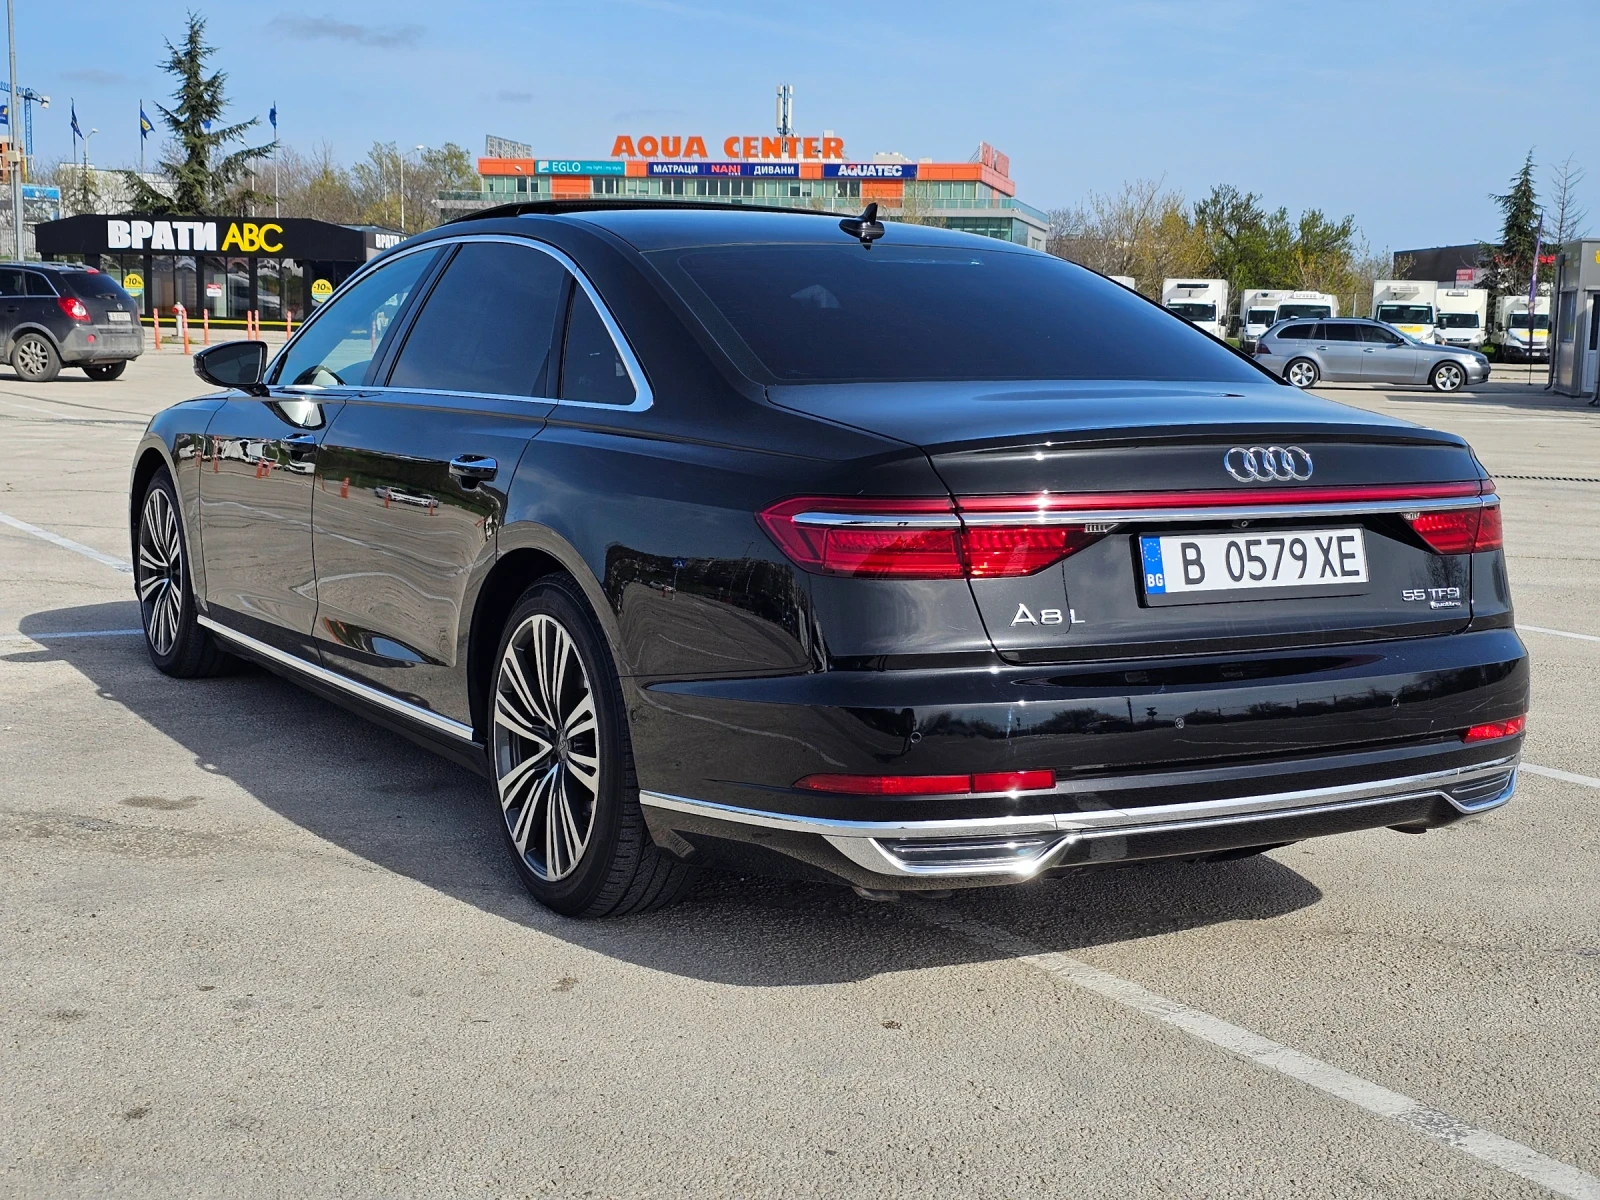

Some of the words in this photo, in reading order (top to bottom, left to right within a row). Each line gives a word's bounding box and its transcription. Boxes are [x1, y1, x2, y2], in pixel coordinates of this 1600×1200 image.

[610, 135, 708, 159] AQUA
[723, 136, 844, 159] CENTER
[552, 161, 581, 173] EGLO
[653, 164, 699, 174] МАТРАЦИ
[711, 164, 741, 173] NANI
[753, 165, 795, 175] ДИВАНИ
[838, 164, 902, 177] AQUATEC
[107, 220, 217, 251] ВРАТИ
[221, 222, 284, 253] ABC
[1180, 541, 1206, 585] B
[1225, 537, 1308, 582] 0579
[1315, 536, 1360, 578] XE
[1147, 573, 1164, 587] BG
[1402, 588, 1426, 601] 55
[1427, 587, 1460, 600] TFSI
